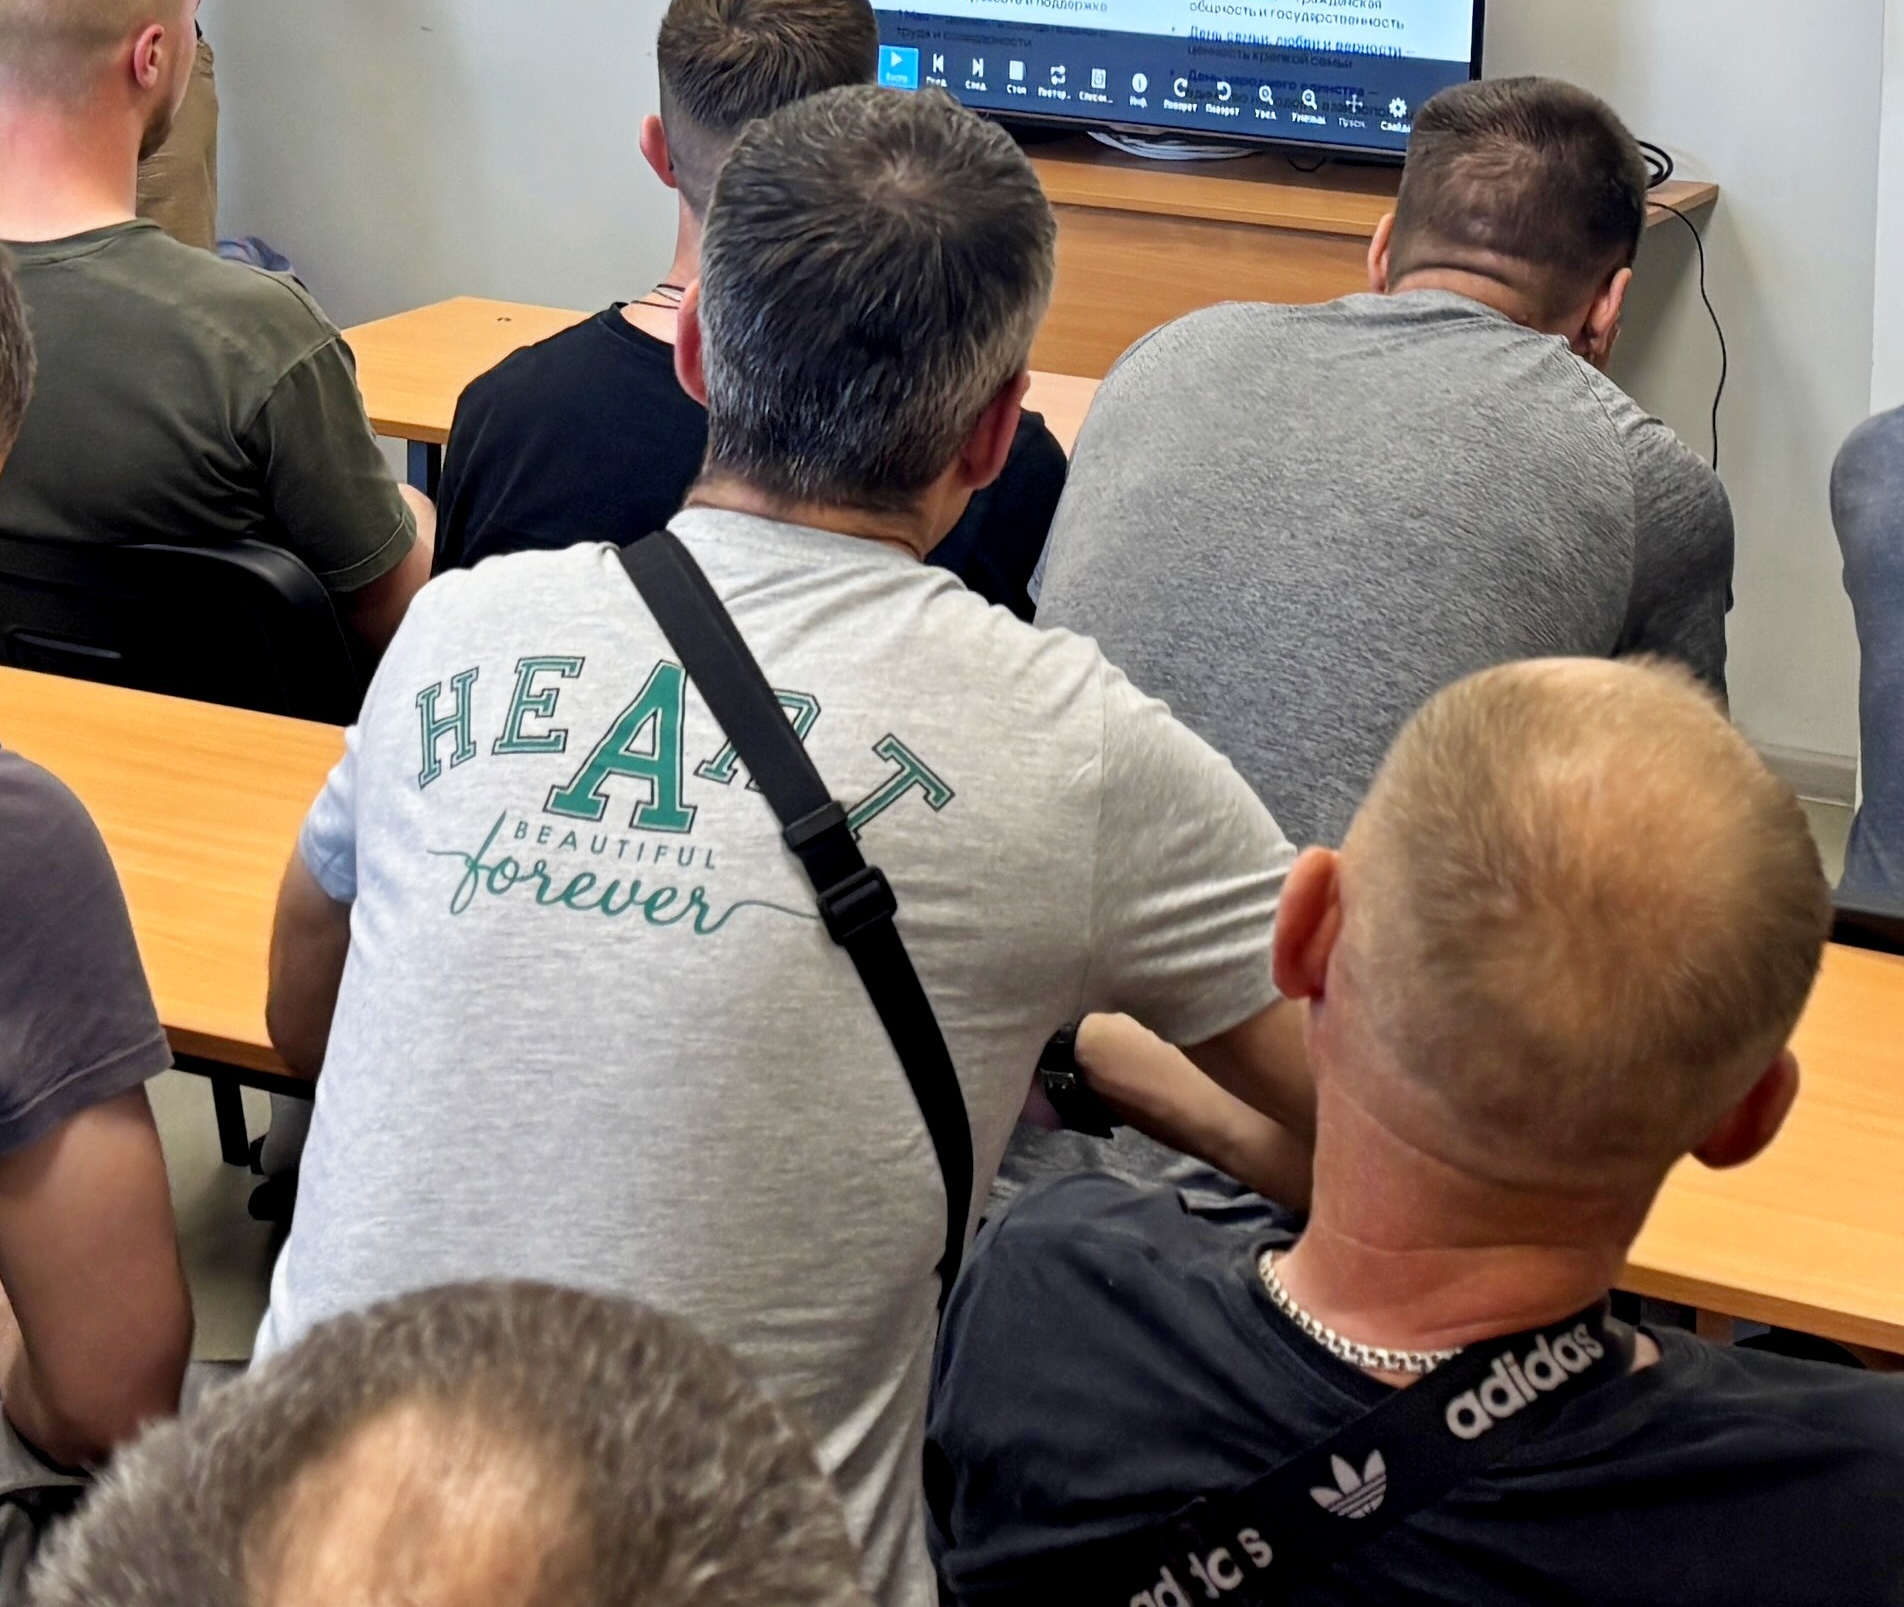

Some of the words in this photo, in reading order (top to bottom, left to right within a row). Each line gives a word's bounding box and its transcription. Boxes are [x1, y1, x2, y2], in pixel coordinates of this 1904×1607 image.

[427, 809, 822, 935] forever
[512, 818, 718, 871] BEAUTIFUL
[1444, 1321, 1605, 1440] adidas
